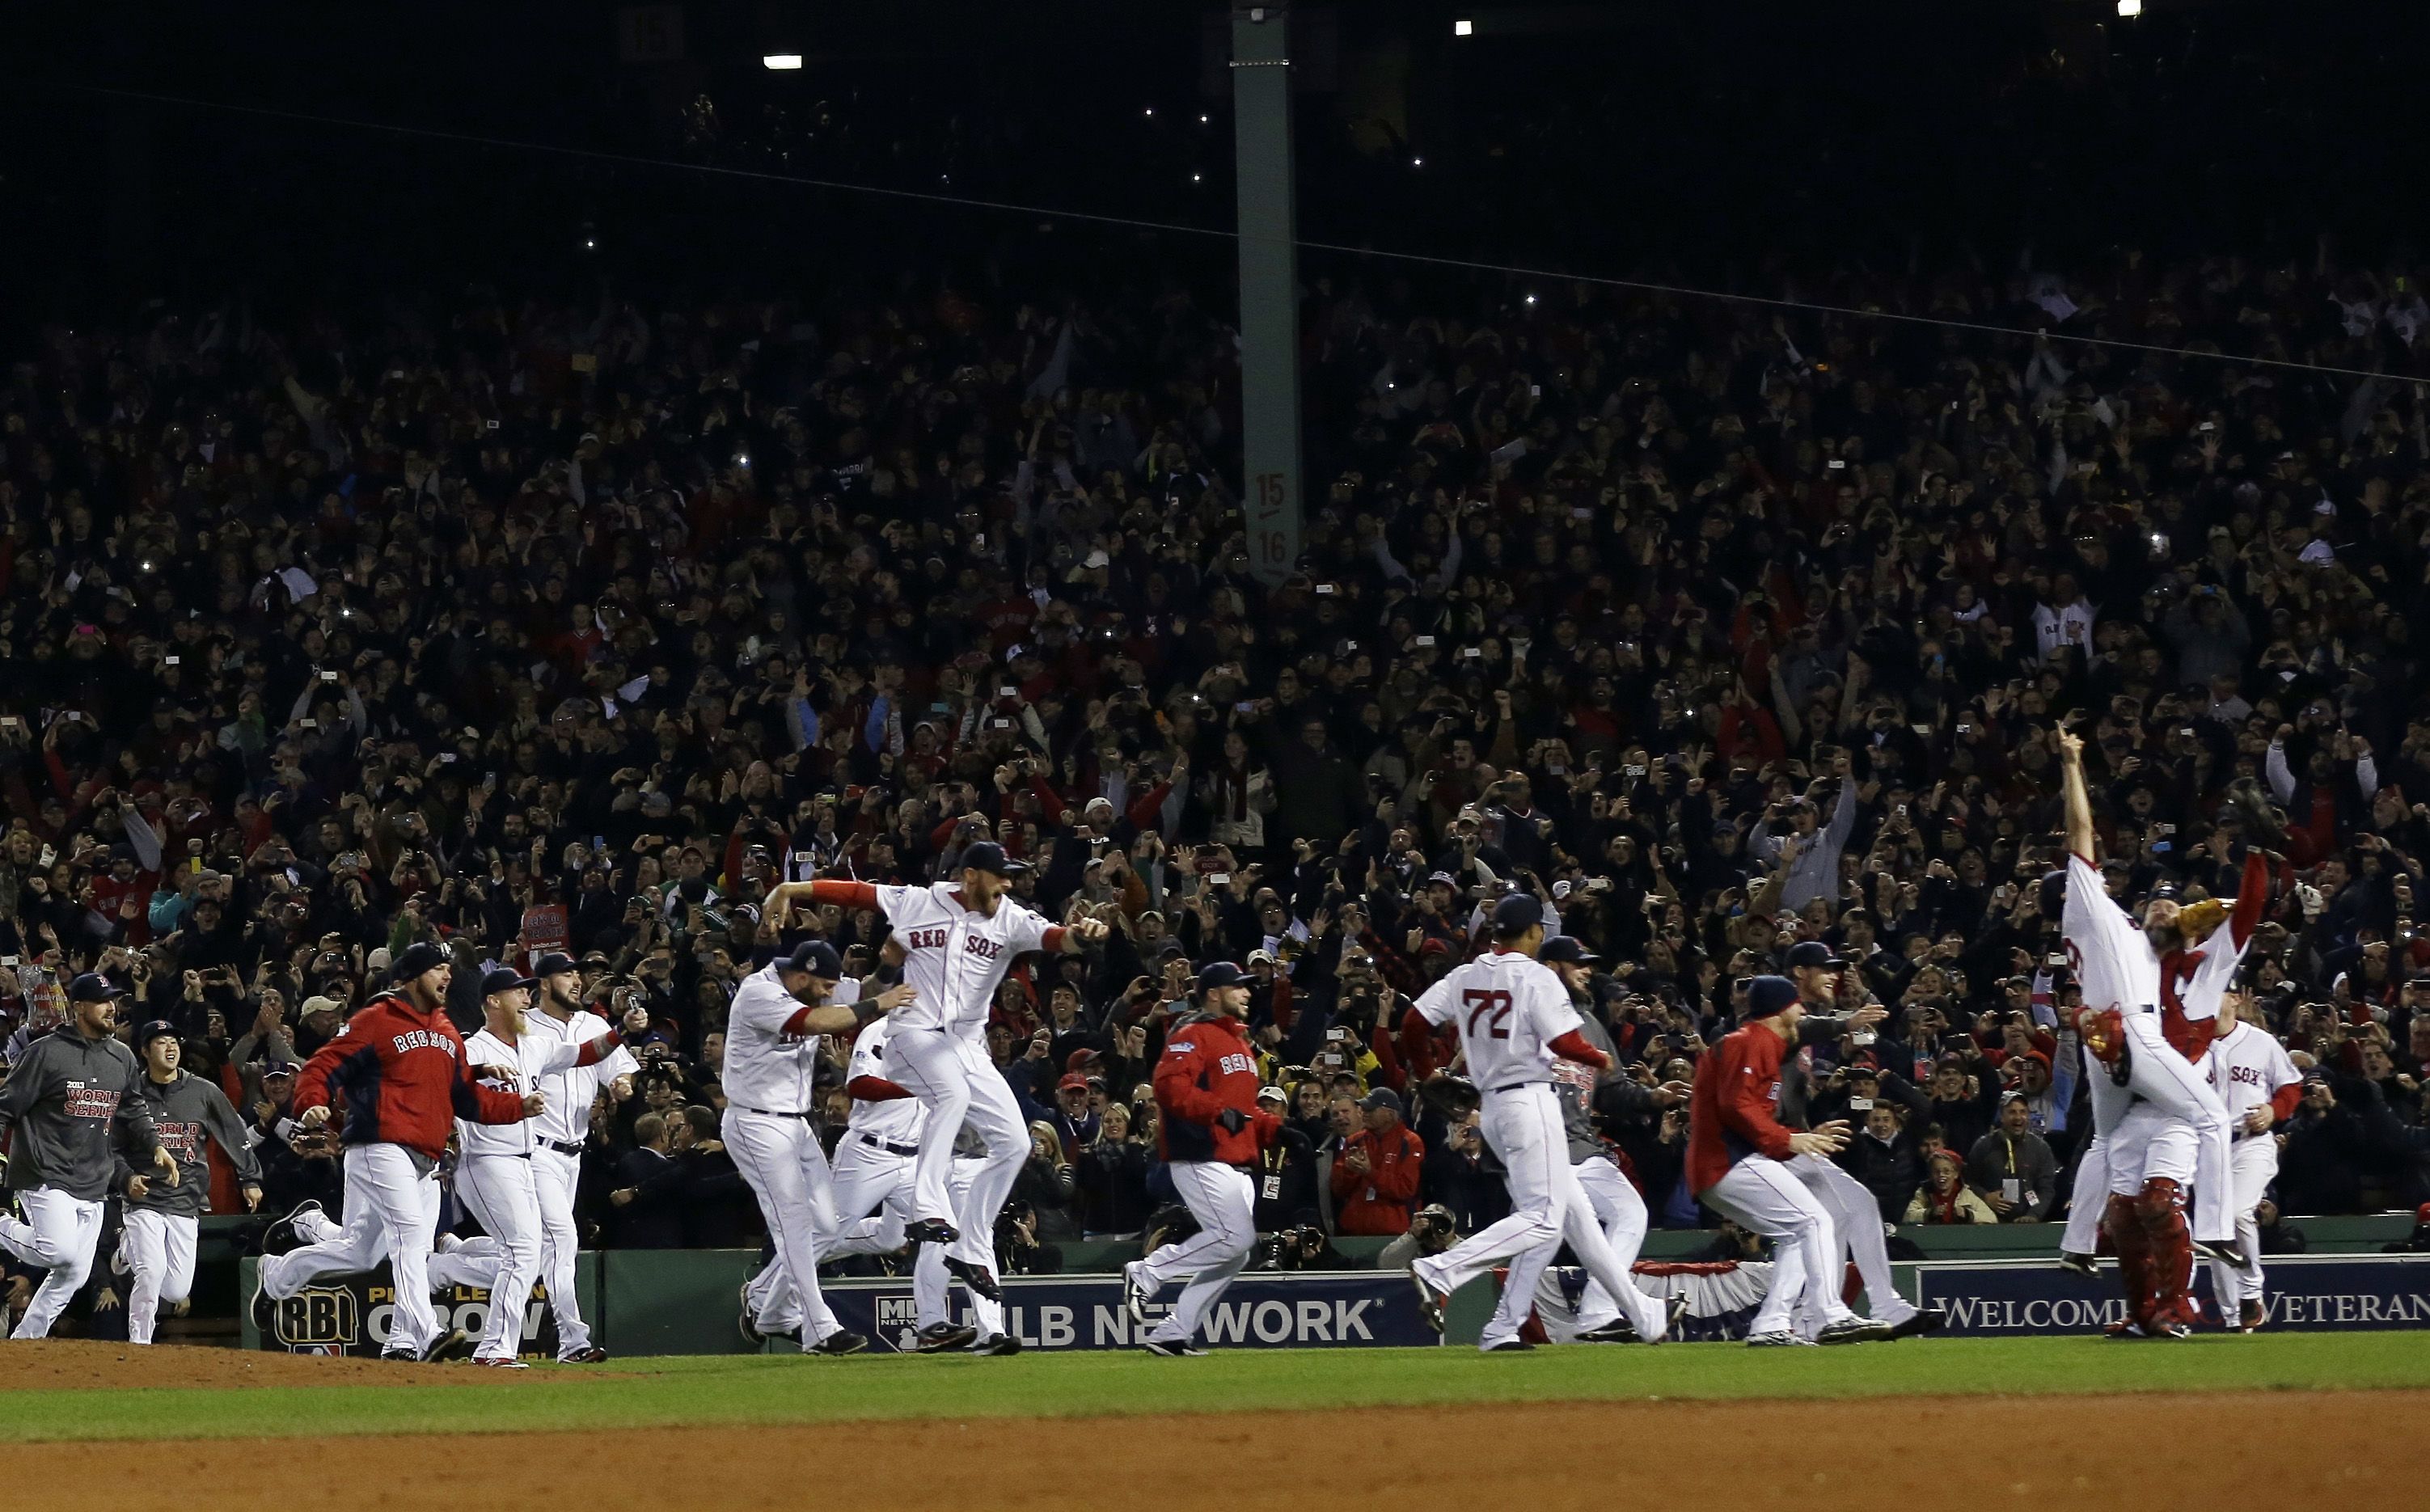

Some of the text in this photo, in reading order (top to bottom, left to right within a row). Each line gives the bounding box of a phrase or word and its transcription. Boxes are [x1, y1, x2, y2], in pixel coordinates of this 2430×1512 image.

[1256, 473, 1284, 506] 15
[1259, 530, 1287, 564] 16
[909, 929, 1004, 960] RED SOX
[1462, 988, 1514, 1040] 72
[393, 1029, 457, 1059] RED SOX
[66, 1080, 85, 1089] 2013
[2230, 1066, 2263, 1086] SOX
[154, 1122, 200, 1137] ORLD
[279, 1294, 357, 1341] RBI
[881, 1300, 919, 1320] ML
[1094, 1299, 1374, 1345] NEWORK
